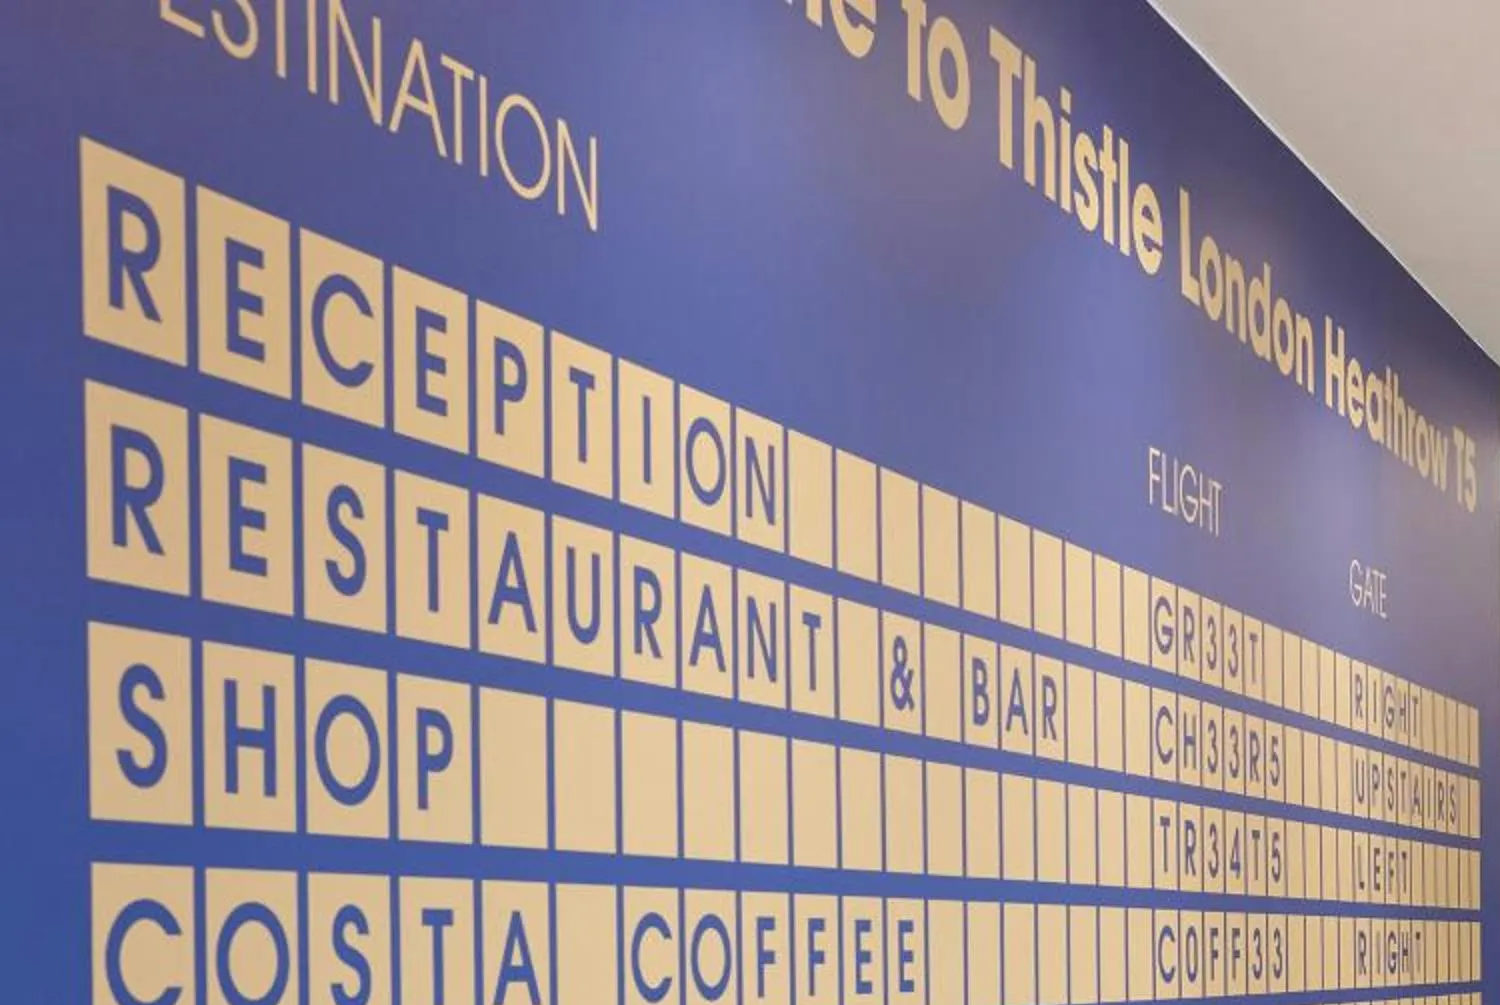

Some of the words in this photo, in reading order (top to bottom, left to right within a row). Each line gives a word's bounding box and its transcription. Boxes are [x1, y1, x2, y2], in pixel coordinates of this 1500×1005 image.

[106, 184, 777, 527] RECEPTION
[1153, 595, 1258, 684] GR33T
[1354, 673, 1419, 737] RIGHT
[159, 0, 597, 232] TINATION
[1149, 446, 1223, 537] FLIGHT
[1350, 559, 1387, 619] GATE
[989, 24, 1163, 275] Thistle
[1179, 186, 1315, 395] London
[1325, 314, 1449, 492] Heathrow
[1452, 425, 1478, 513] T5
[109, 423, 822, 692] RESTAURANT
[890, 635, 915, 712] &
[971, 656, 1060, 741] BAR
[1154, 704, 1281, 787] CH33R5
[1355, 758, 1457, 825] UPSTAIRS
[115, 662, 455, 811] SHOP
[1357, 845, 1408, 894] LEFT
[629, 910, 916, 1004] COFFEE
[1358, 930, 1421, 975] RIGHT
